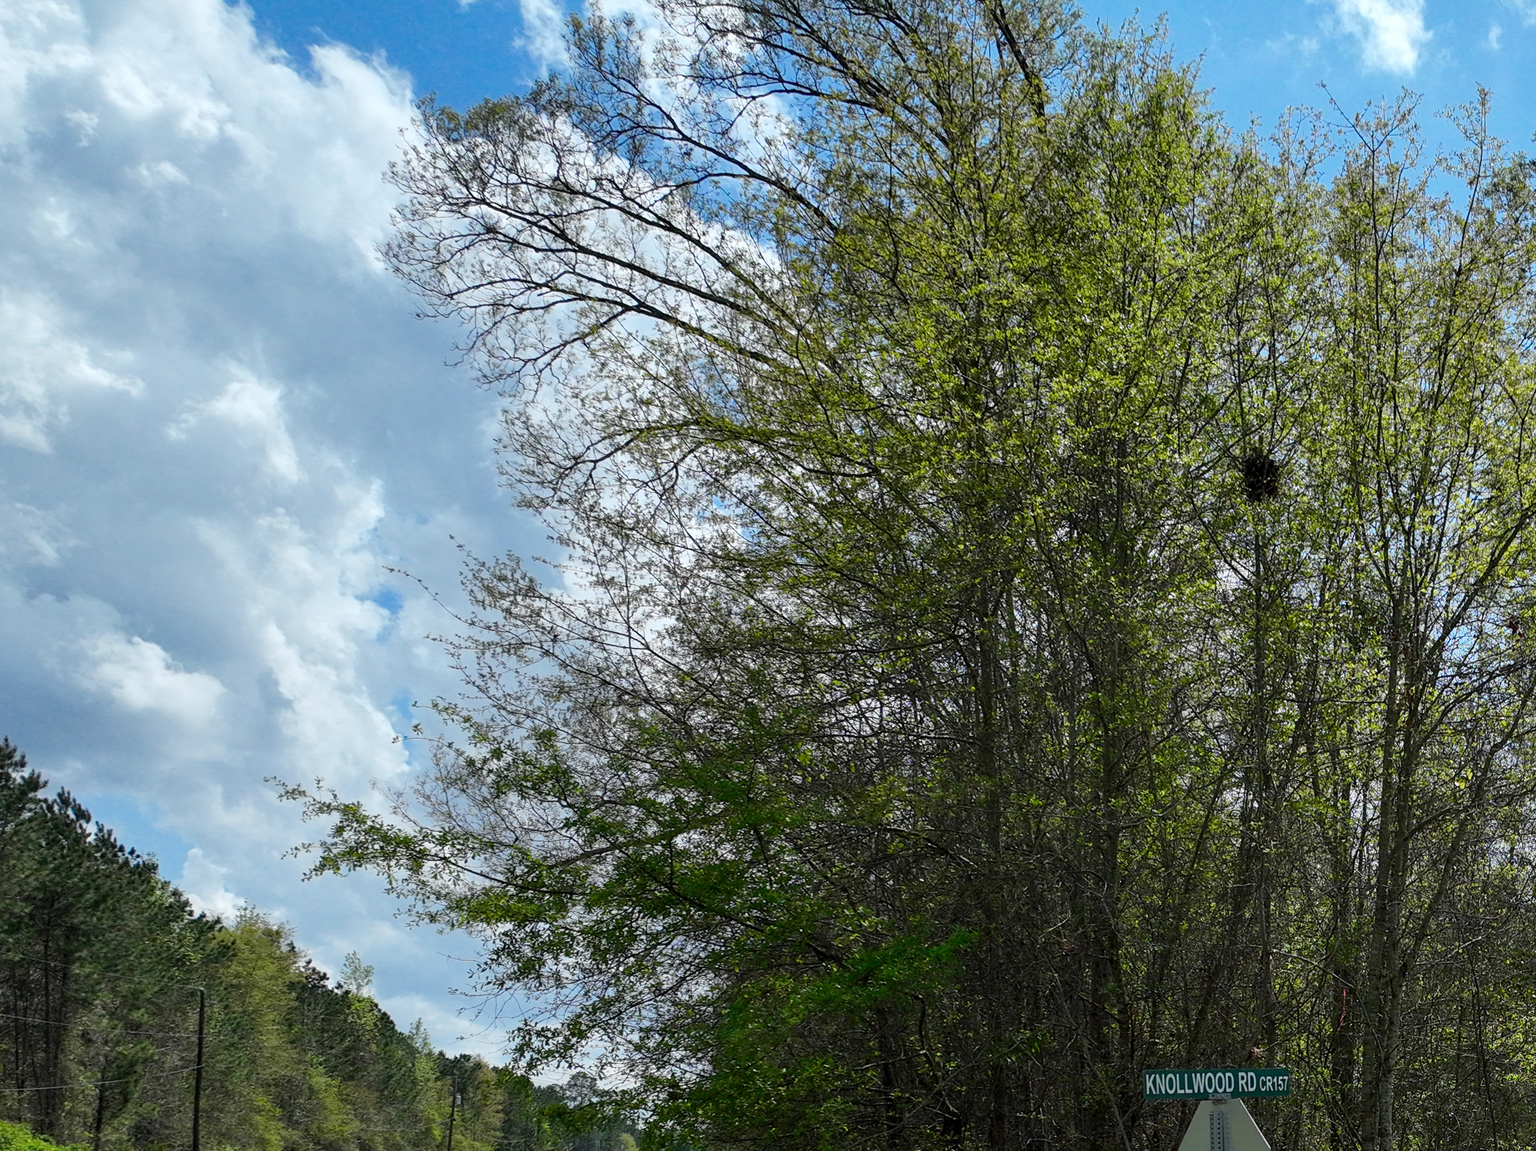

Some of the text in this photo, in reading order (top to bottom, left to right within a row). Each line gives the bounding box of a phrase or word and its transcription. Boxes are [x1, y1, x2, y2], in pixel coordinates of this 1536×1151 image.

[1145, 1071, 1288, 1095] KNOLLWOOD RD CR157
